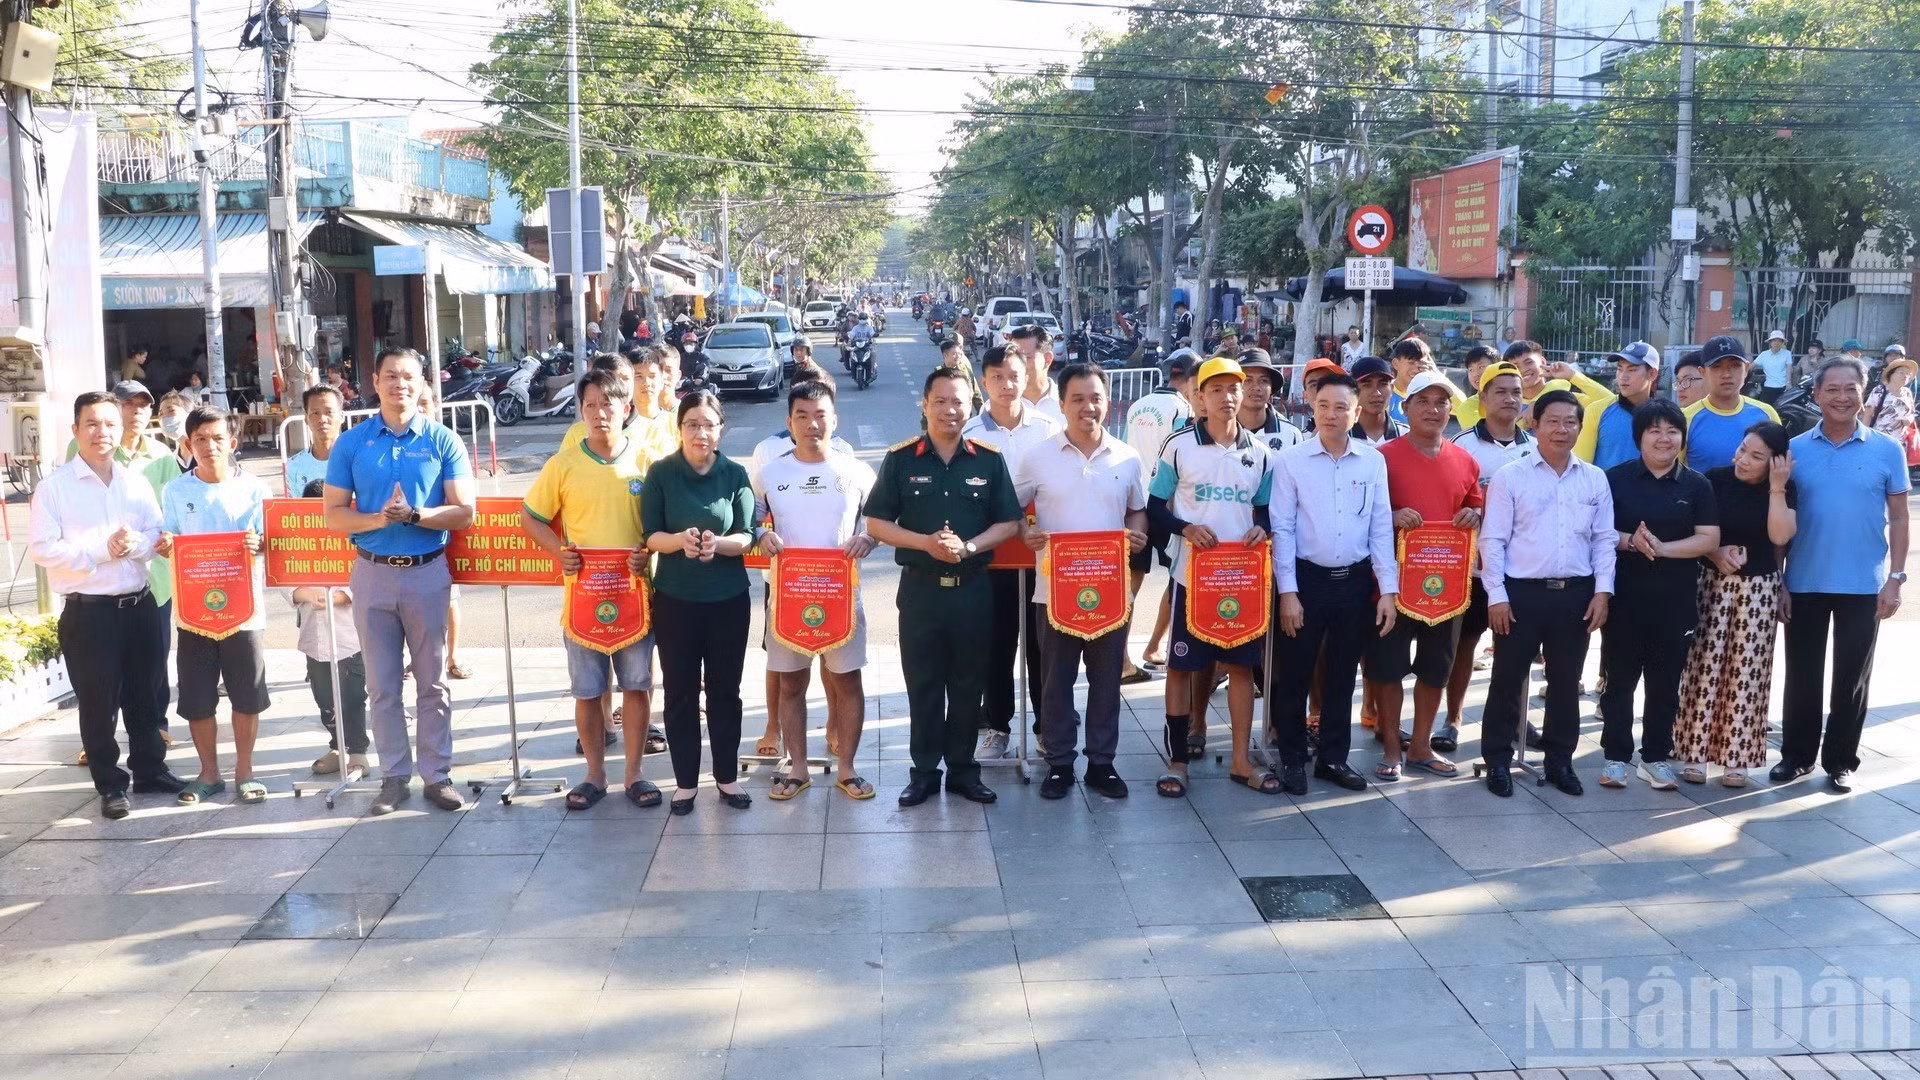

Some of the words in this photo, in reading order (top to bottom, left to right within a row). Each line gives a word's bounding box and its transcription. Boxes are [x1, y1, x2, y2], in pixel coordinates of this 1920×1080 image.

[1455, 198, 1469, 208] CÁCH
[1455, 212, 1472, 221] THÁNG
[1457, 223, 1470, 234] QUỐC
[1472, 223, 1490, 233] KHÁNH
[114, 282, 142, 304] SƯỜN
[145, 286, 166, 304] NON
[282, 513, 300, 531] ĐỘI
[474, 511, 485, 529] ỘI
[490, 511, 521, 527] PHƯỜ
[270, 535, 316, 550] PHƯỜNG
[320, 535, 341, 550] TÂN
[466, 534, 489, 549] TÂN
[493, 534, 526, 550] UYÊN
[284, 556, 310, 573] TỈNH
[314, 556, 344, 573] ĐỒNG
[455, 558, 471, 571] TP.
[475, 554, 491, 572] HỒ
[496, 556, 516, 572] CHÍ
[520, 559, 553, 572] MINH
